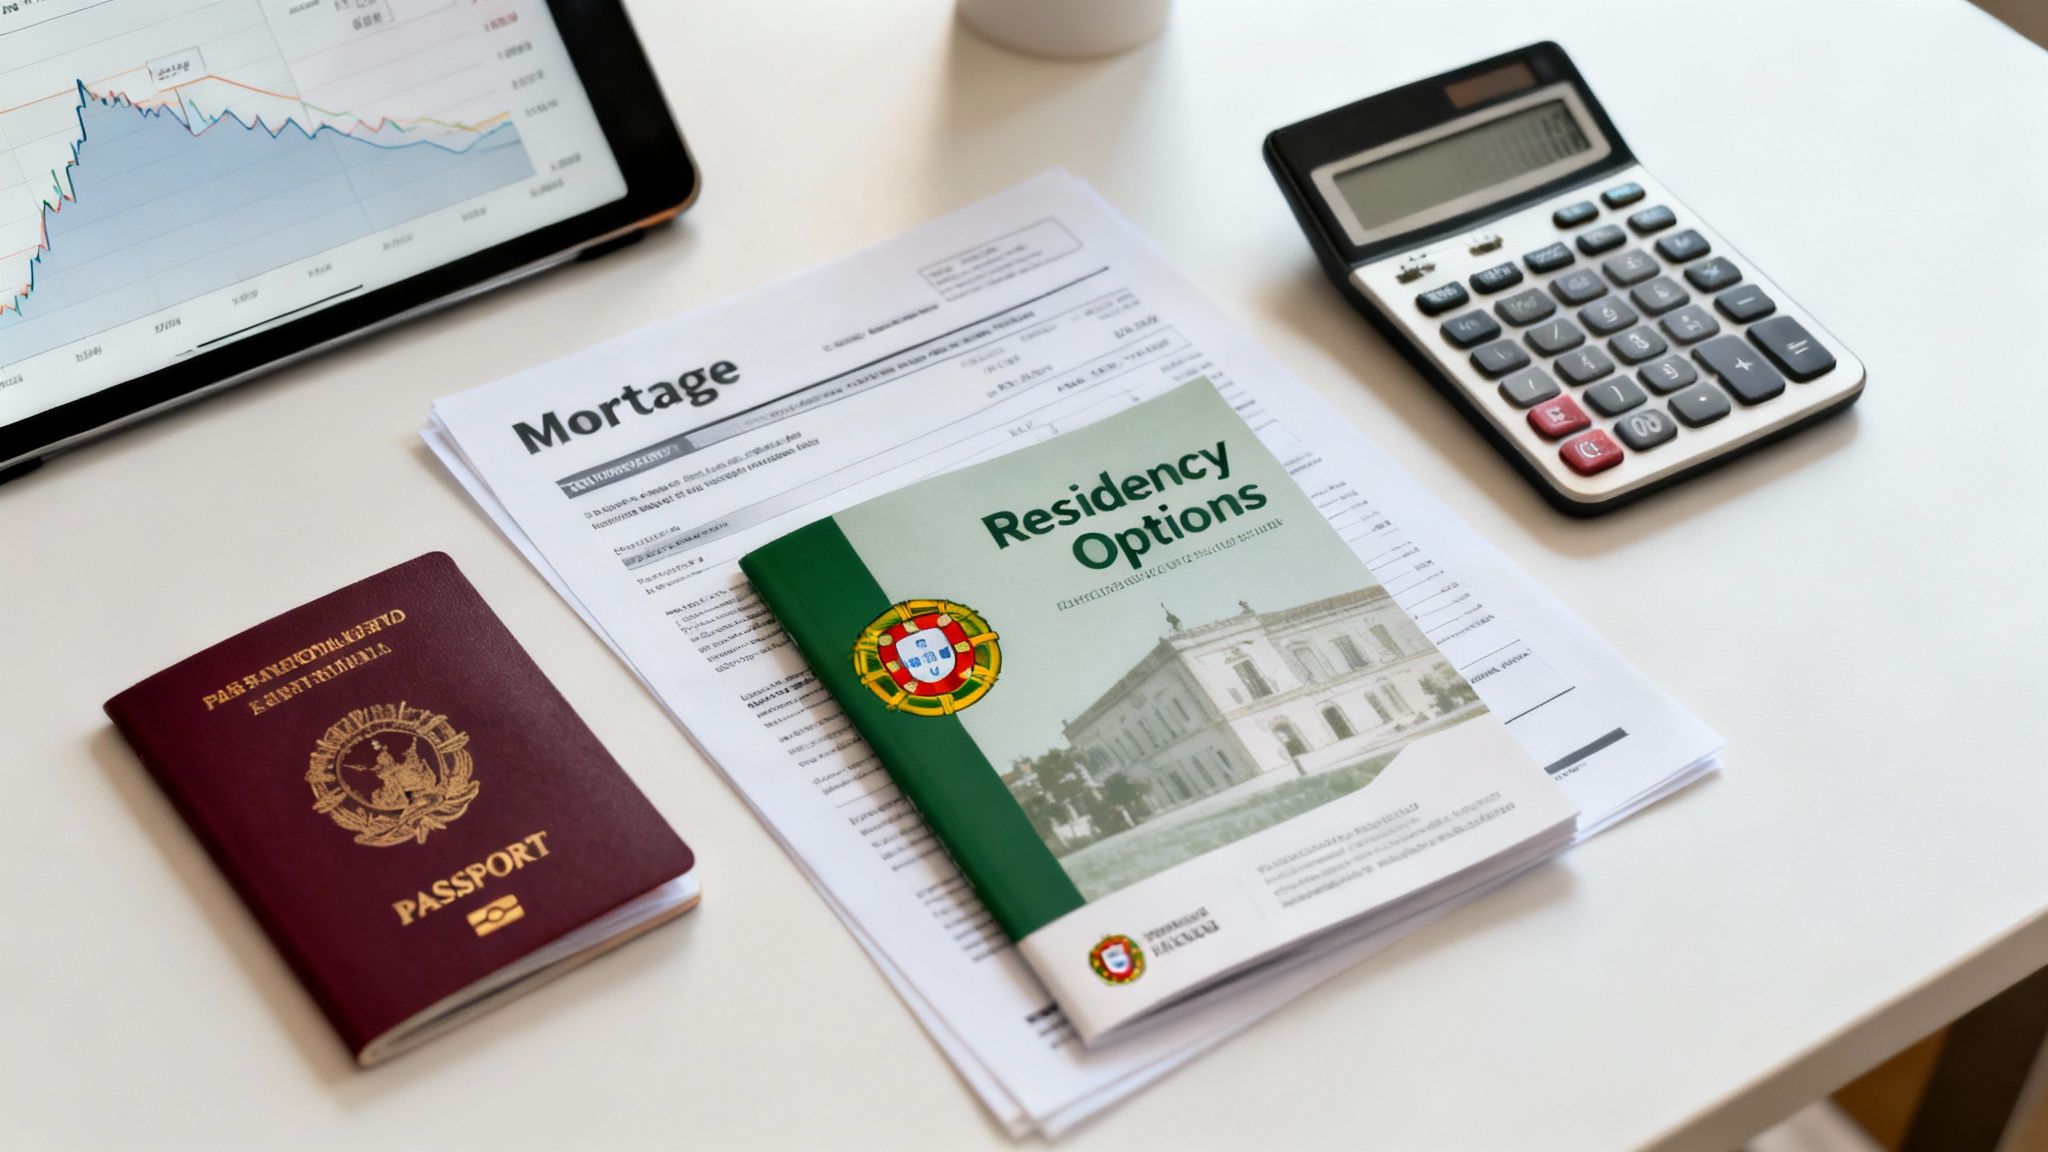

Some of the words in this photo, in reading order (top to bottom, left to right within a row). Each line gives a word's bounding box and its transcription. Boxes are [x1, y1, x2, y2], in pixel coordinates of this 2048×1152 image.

[512, 357, 741, 456] Mortage
[980, 439, 1231, 551] Residency
[1071, 480, 1268, 572] Options
[391, 830, 551, 927] PASSPORT
